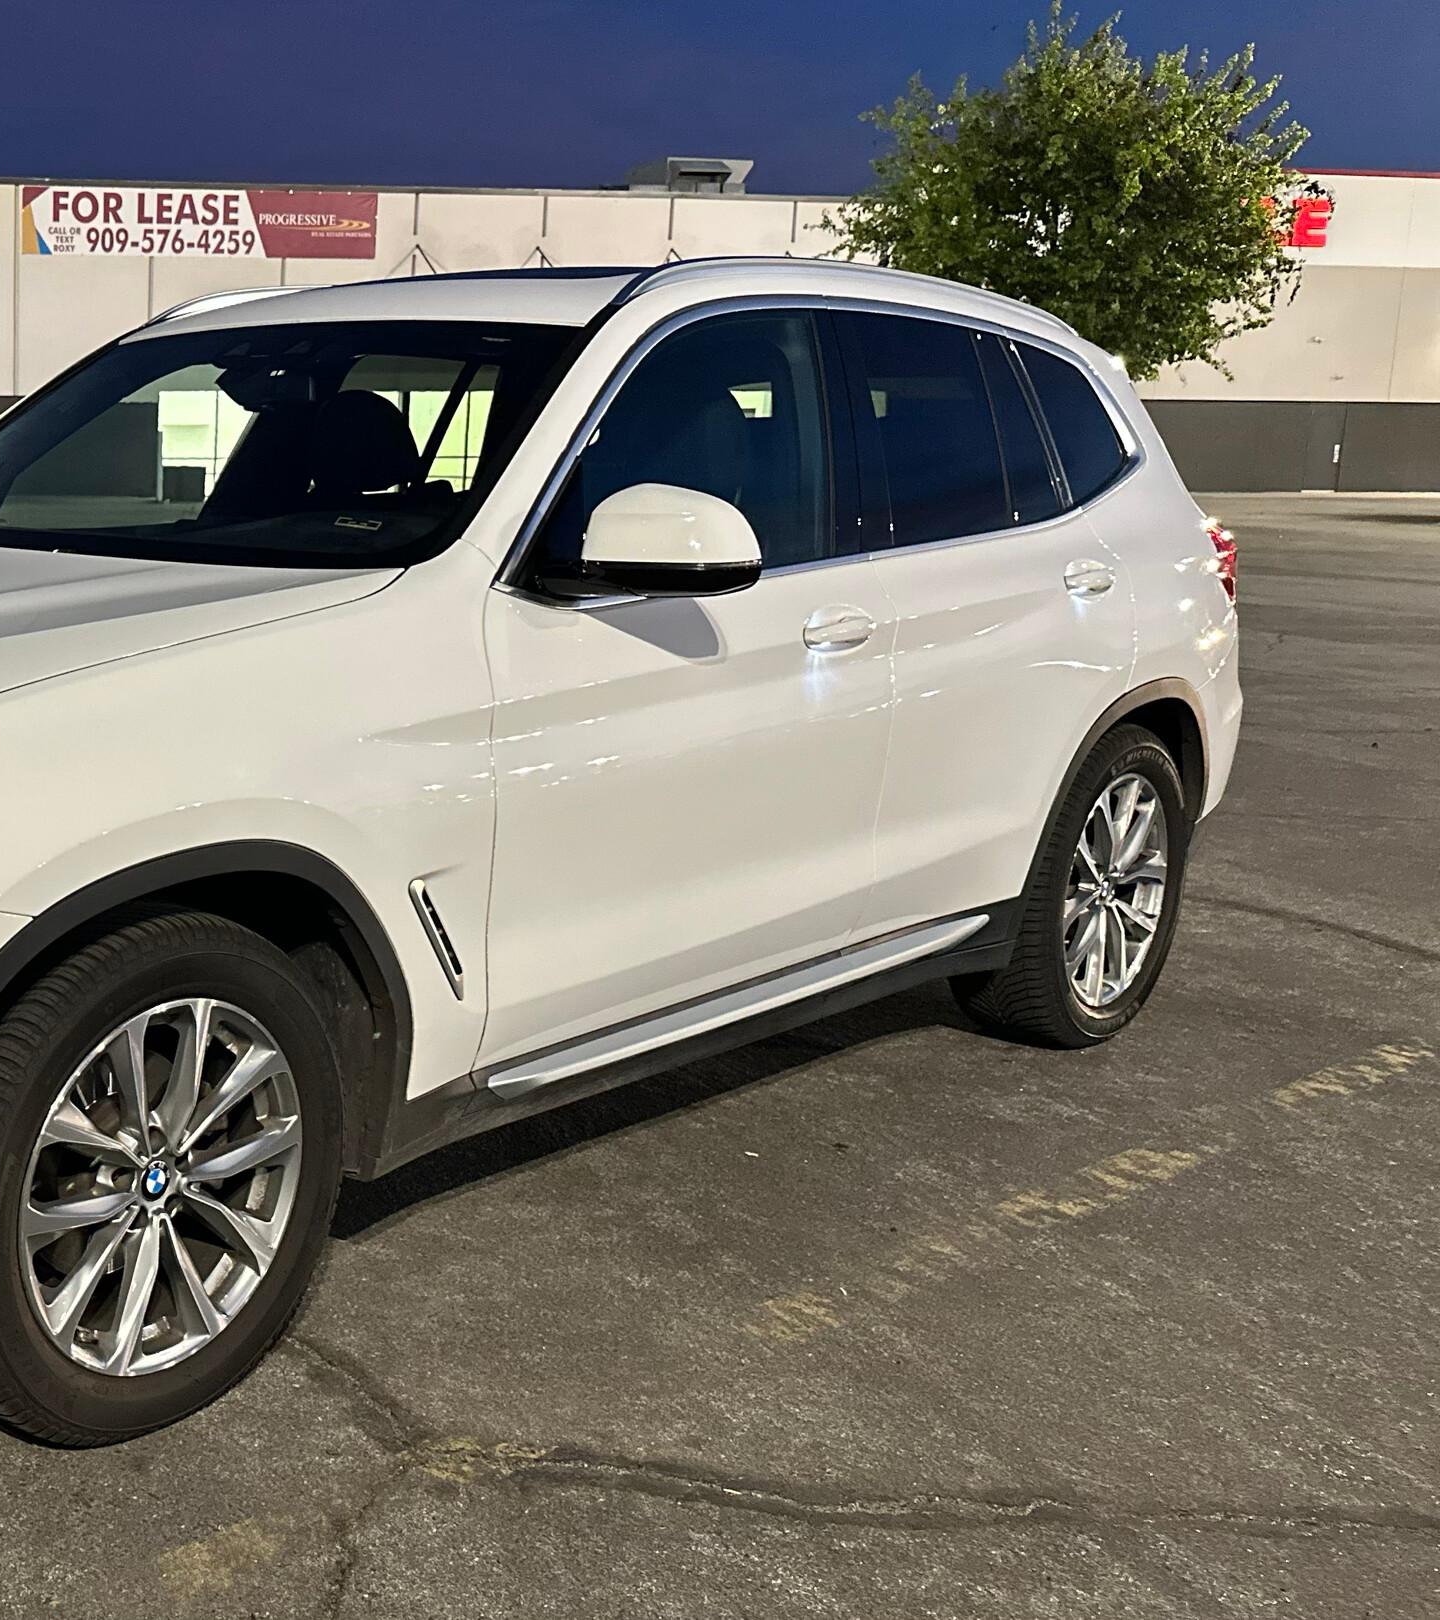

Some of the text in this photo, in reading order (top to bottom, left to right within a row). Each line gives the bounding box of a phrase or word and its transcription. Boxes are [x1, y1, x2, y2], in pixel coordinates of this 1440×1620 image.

[52, 191, 239, 226] FOR LEASE
[259, 212, 337, 226] PROGRESSIVE
[48, 227, 81, 235] CALL OR
[55, 236, 74, 244] TEXT
[86, 227, 255, 255] 909-576-4259
[53, 245, 75, 253] ROXY
